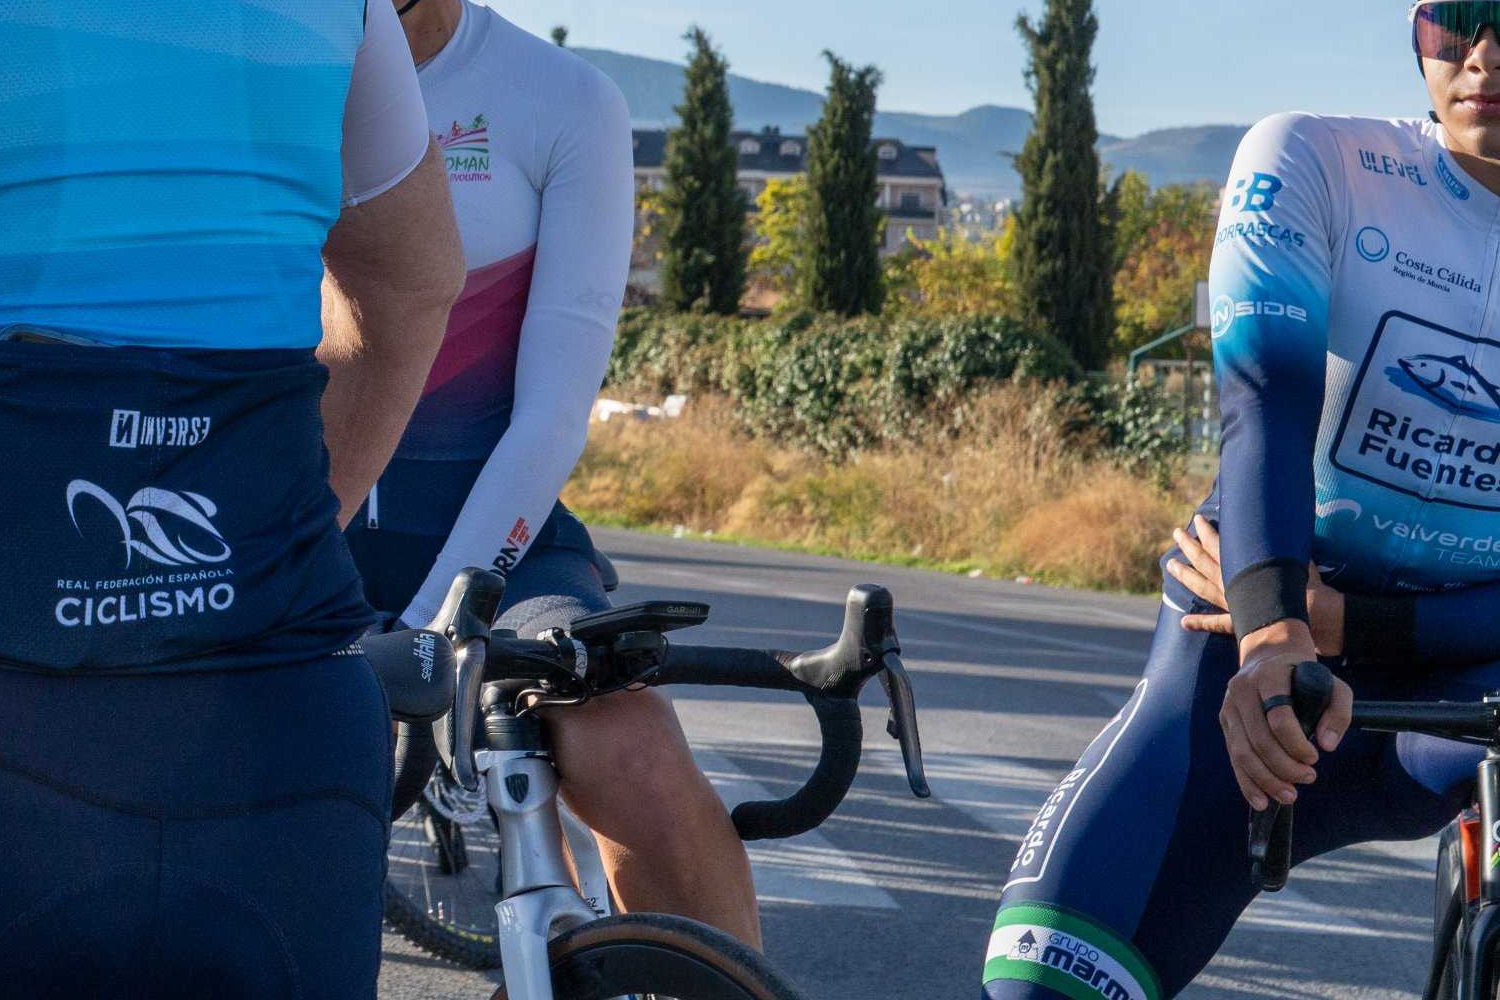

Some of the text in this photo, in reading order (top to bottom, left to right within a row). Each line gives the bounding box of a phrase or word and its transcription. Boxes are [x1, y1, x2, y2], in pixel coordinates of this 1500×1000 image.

[1395, 250, 1482, 293] Costa Cálida
[57, 568, 235, 591] REAL FEDERACIÓN ESPAÑOLA
[54, 582, 236, 627] CICLISMO
